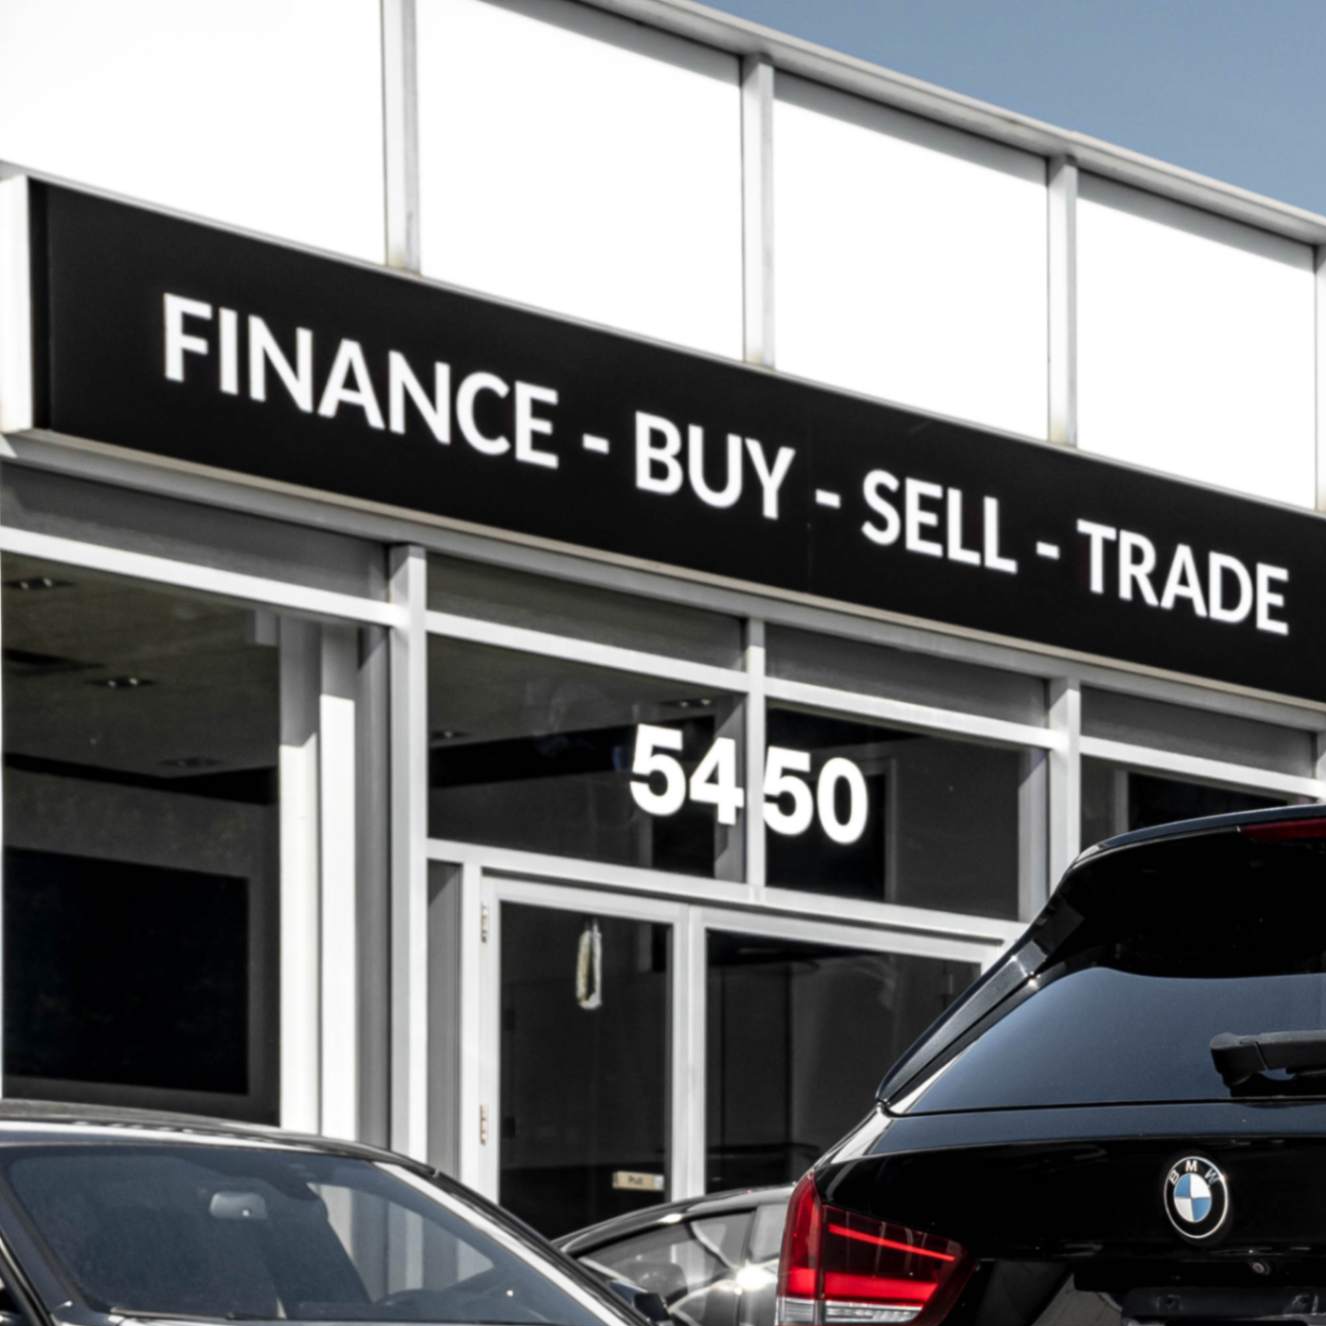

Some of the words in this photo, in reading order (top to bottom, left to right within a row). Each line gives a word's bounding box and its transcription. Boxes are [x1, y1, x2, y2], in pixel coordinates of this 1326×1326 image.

[163, 292, 559, 469] FINANCE
[635, 411, 796, 520] BUY
[861, 469, 1018, 574] SELL
[1076, 518, 1289, 636] TRADE
[629, 723, 869, 845] 5450
[1168, 1159, 1222, 1185] BMW
